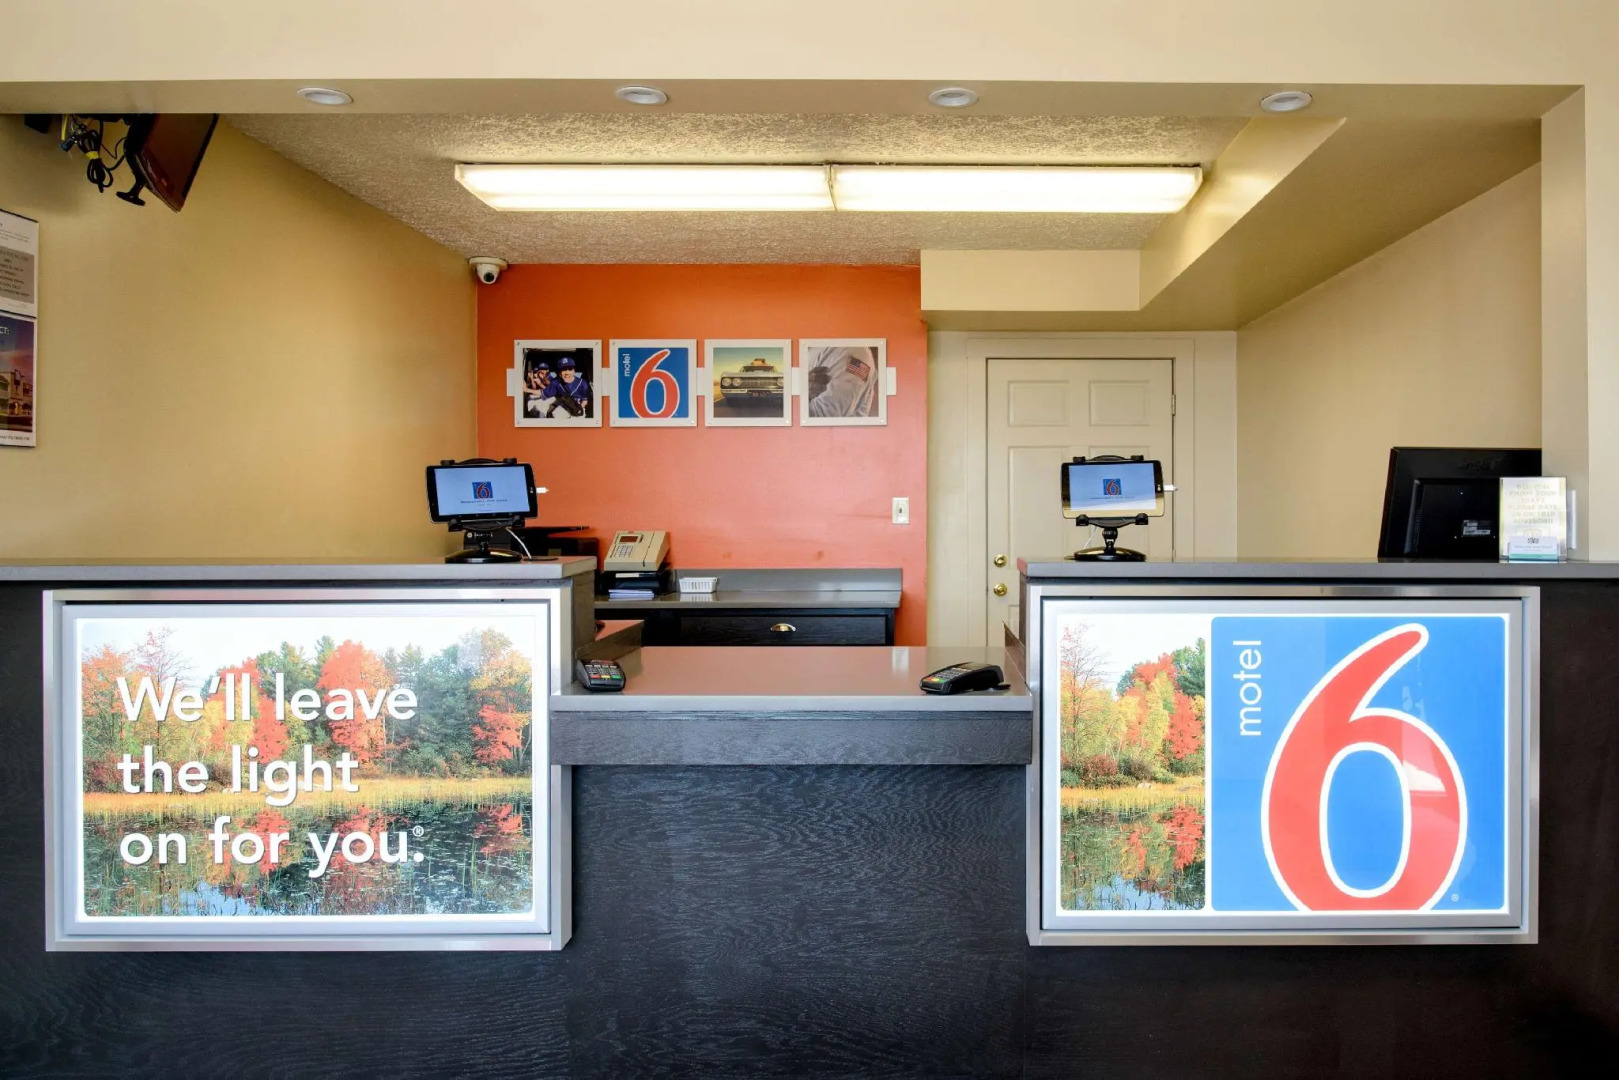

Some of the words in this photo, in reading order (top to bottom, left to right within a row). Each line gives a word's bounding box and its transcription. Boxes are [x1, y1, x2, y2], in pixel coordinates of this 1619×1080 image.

[623, 353, 631, 377] motel
[630, 349, 680, 418] 6
[117, 672, 251, 722] We'll
[275, 672, 418, 722] leave
[1233, 640, 1262, 737] motel
[117, 745, 209, 794] the
[232, 744, 360, 807] light
[1261, 623, 1468, 911] 6
[119, 830, 188, 866] on
[208, 816, 290, 865] for
